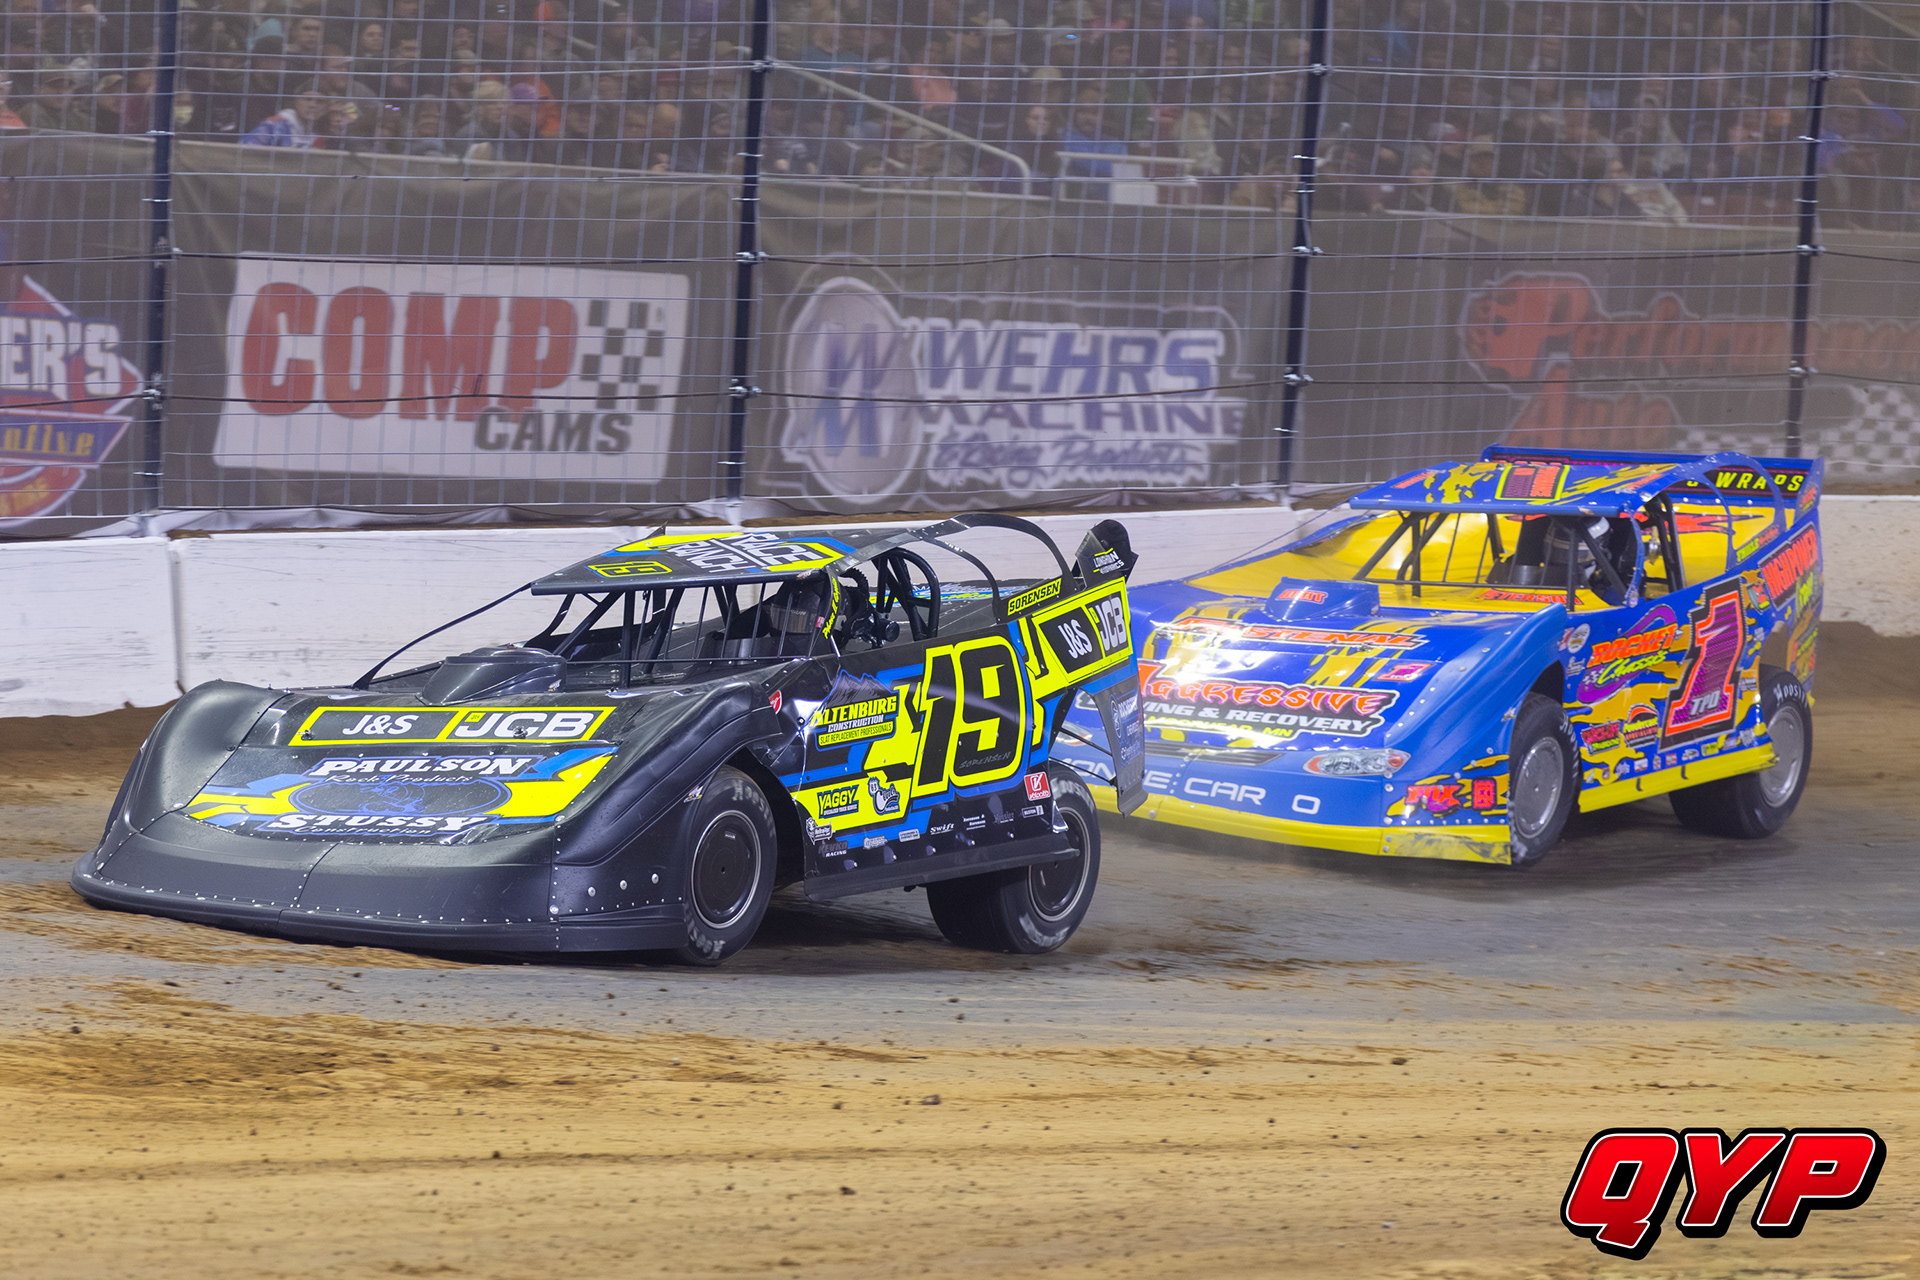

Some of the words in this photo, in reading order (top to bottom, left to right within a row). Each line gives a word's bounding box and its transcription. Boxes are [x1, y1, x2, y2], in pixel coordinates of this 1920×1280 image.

[242, 282, 578, 421] COMP
[926, 327, 1218, 397] WEHRS
[474, 406, 633, 454] CAMS
[668, 540, 756, 573] RANCH
[738, 533, 822, 562] RACE
[1009, 582, 1060, 613] SORENSEN
[1058, 619, 1093, 659] J&S
[1095, 597, 1127, 651] JCB
[1171, 616, 1416, 648] FSTENAL
[1586, 623, 1678, 668] ROCKET
[1597, 650, 1669, 684] Chassis
[1665, 590, 1741, 738] 1
[810, 696, 897, 727] ALTENBURG
[916, 642, 1022, 793] 19
[1144, 702, 1187, 717] ING
[1201, 707, 1220, 720] &
[1225, 710, 1373, 733] RECOVERY
[1691, 690, 1721, 715] TPO
[343, 713, 419, 735] J&S
[455, 711, 596, 739] JCB
[820, 734, 831, 744] SLAT
[831, 730, 860, 741] REPLACEMENT
[860, 723, 892, 736] PROFESSIONALS
[828, 714, 884, 733] CONSTRUCTION
[1262, 726, 1294, 738] MN
[309, 757, 532, 777] PAULSON
[325, 775, 381, 783] Rock
[384, 774, 473, 783] Products
[818, 788, 856, 816] YAGGY
[266, 813, 487, 832] STUSSY
[297, 824, 432, 836] Construction
[930, 822, 955, 834] Swift
[825, 849, 848, 858] RACING
